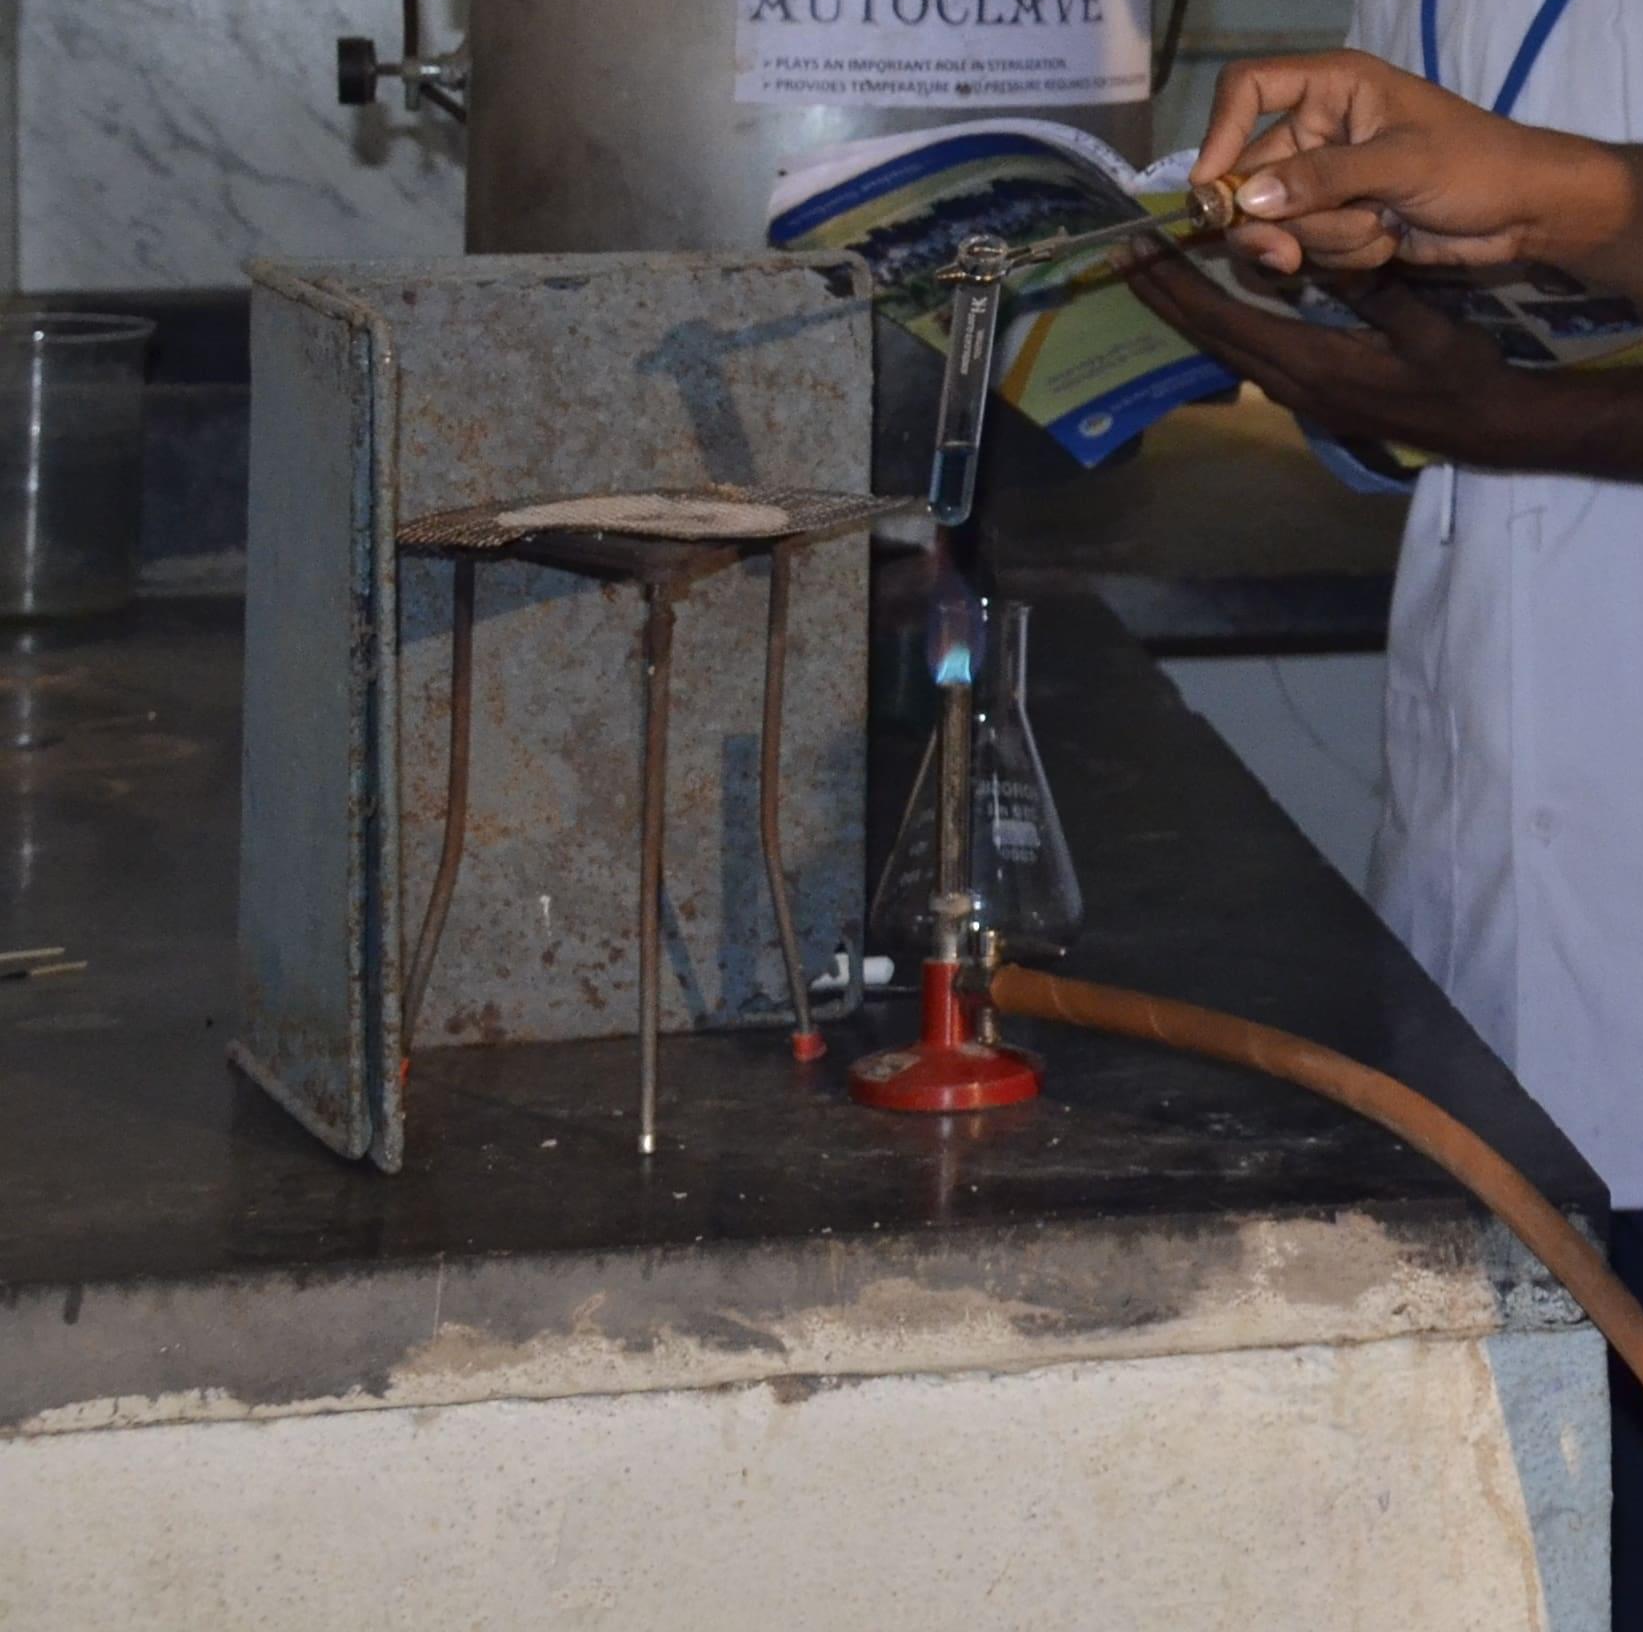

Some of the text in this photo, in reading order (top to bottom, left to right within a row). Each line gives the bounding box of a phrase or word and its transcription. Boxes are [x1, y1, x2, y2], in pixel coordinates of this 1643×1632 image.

[776, 57, 819, 69] PLAYS
[823, 57, 844, 69] AN
[848, 57, 931, 71] IMPORTANT
[935, 57, 967, 71] ROLE
[970, 58, 985, 70] IN
[776, 80, 846, 93] PROVIDES
[851, 79, 950, 95] TEMPERATURE
[984, 79, 1043, 94] PRESSURE
